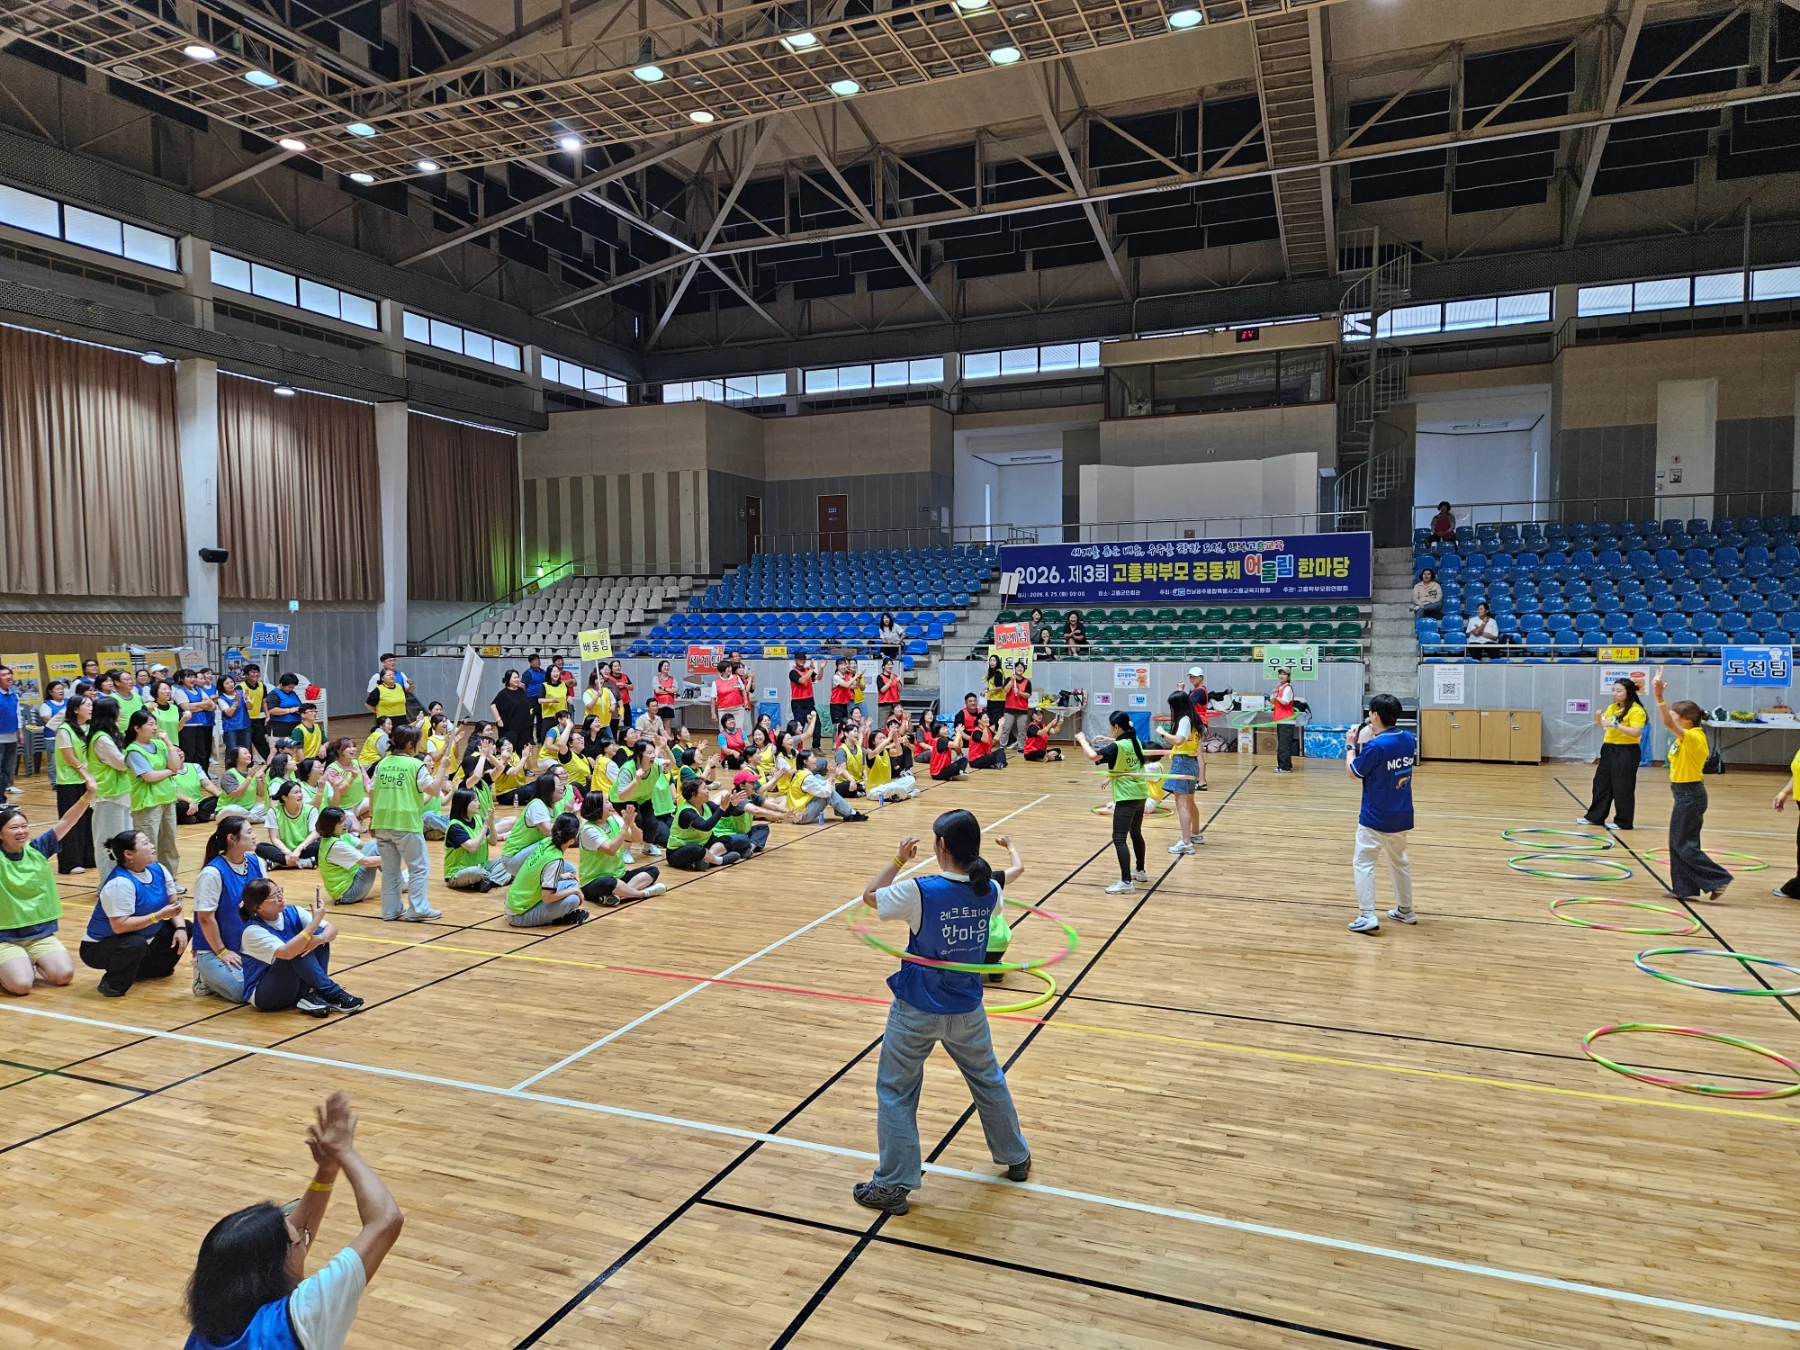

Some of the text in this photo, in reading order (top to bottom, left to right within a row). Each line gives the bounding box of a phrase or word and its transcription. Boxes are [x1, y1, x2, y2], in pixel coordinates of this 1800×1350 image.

[1015, 553, 1350, 584] 2026. 제3회 고흥학부모 공동체 어울림 한마당
[254, 632, 286, 645] 도전팀
[996, 631, 1028, 644] 세계팀
[583, 639, 609, 654] 배움팀
[689, 655, 721, 669] 세계팀
[1267, 657, 1313, 672] 우주팀
[1726, 659, 1787, 678] 도전팀
[1387, 758, 1402, 771] MC
[380, 773, 405, 787] 한마음
[940, 907, 990, 921] 레크토피아
[941, 918, 988, 945] 한마음
